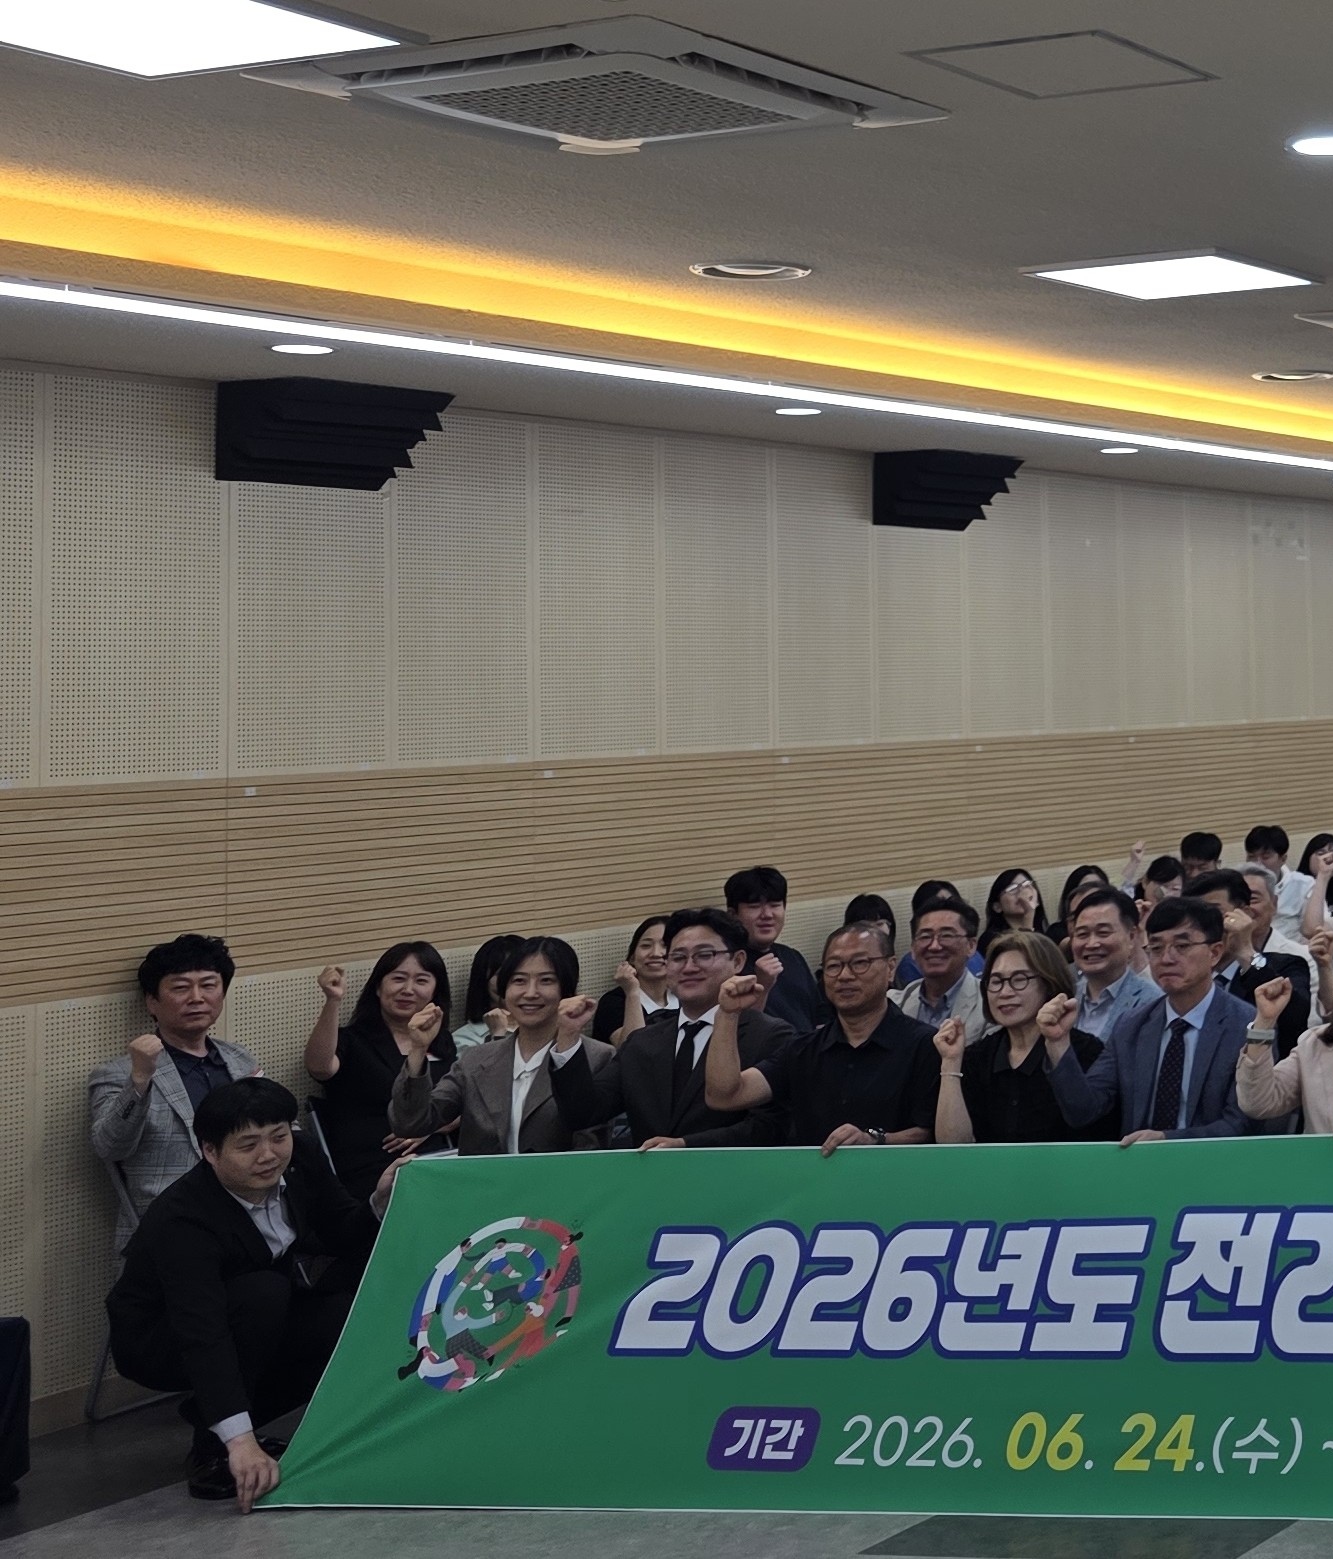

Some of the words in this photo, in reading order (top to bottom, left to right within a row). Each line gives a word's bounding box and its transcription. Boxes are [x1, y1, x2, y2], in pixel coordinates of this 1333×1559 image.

[613, 1222, 1152, 1355] 2026년도
[723, 1418, 805, 1460] 기간
[834, 1414, 982, 1468] 2026.
[1006, 1411, 1094, 1471] 06.
